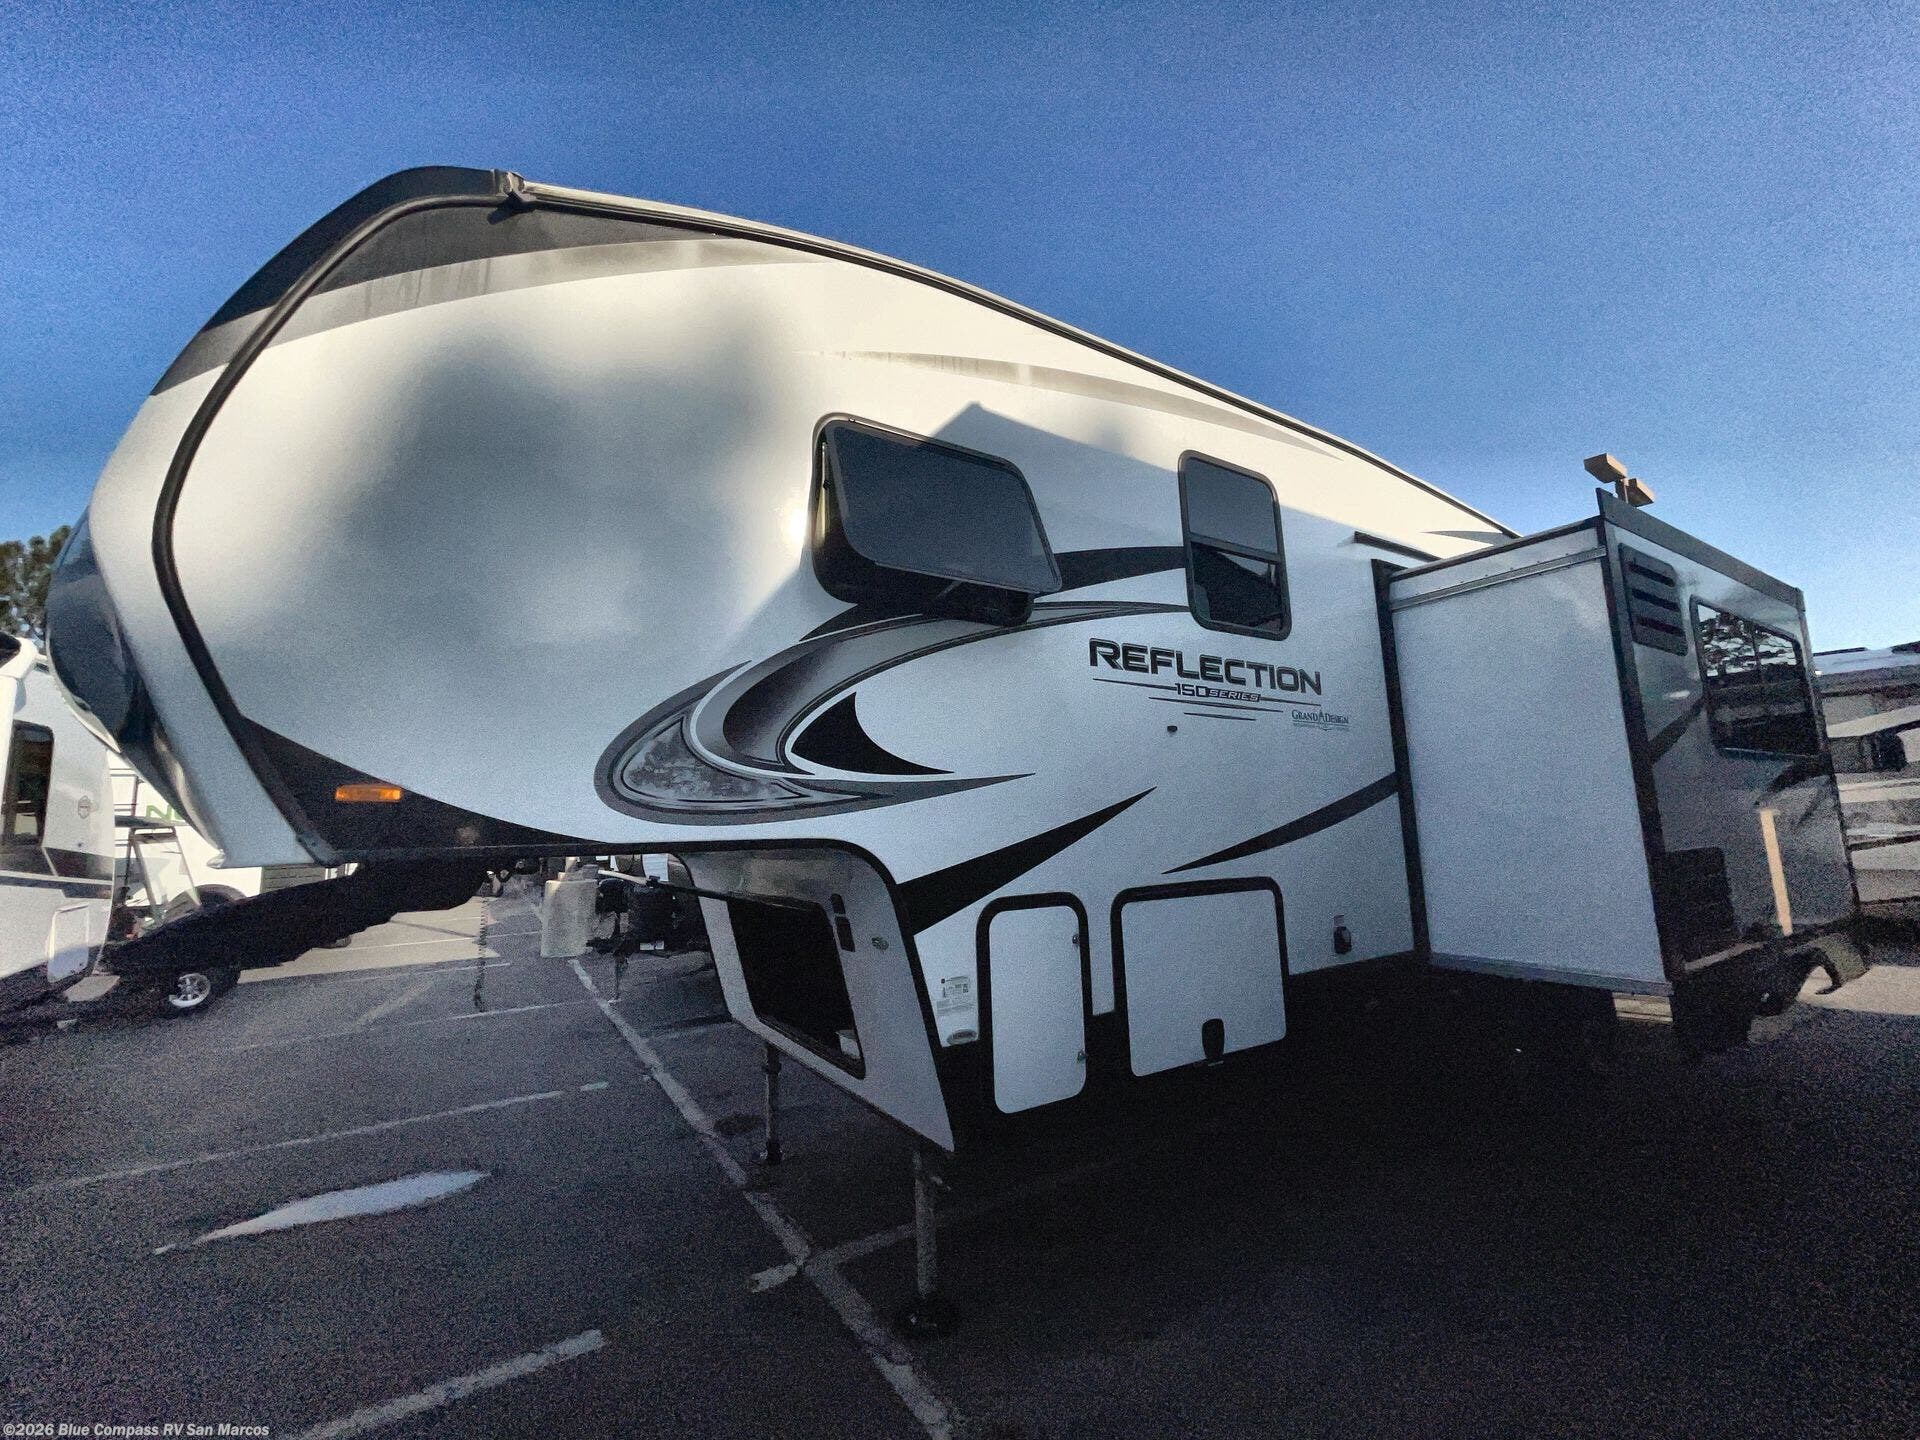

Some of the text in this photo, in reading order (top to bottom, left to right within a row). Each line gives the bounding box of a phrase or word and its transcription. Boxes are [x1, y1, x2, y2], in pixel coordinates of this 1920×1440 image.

[1089, 638, 1322, 695] REFLECTION
[1175, 682, 1260, 702] 150 SERIES
